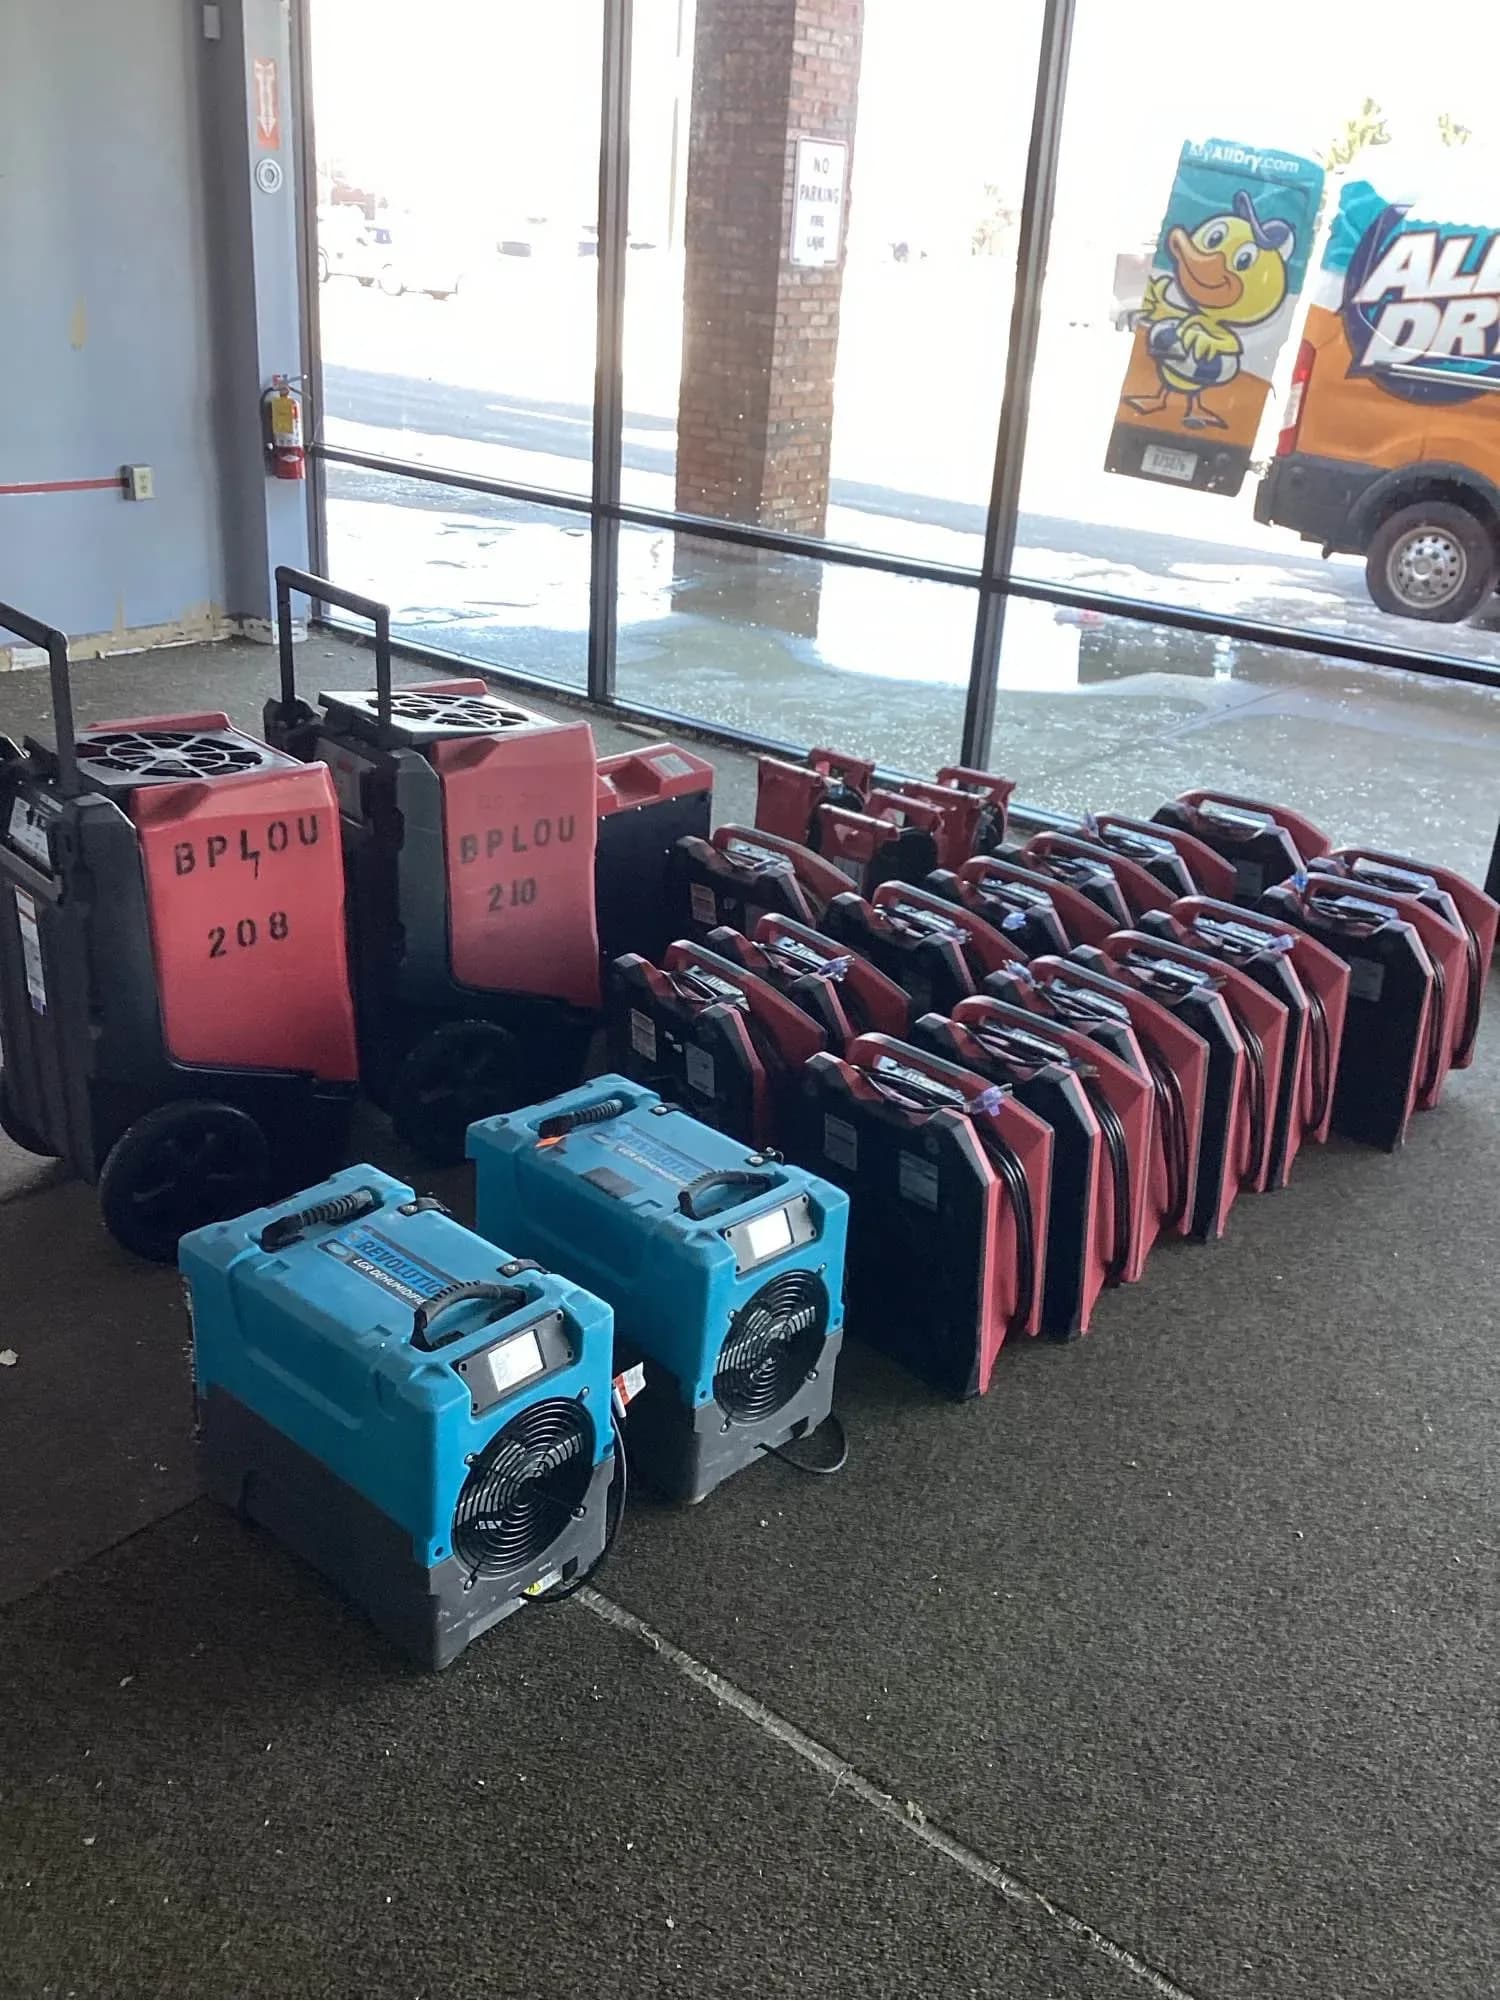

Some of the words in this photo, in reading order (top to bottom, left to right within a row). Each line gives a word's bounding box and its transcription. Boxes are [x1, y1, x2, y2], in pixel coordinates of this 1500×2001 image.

[813, 156, 830, 174] NO
[799, 183, 840, 205] PARKING
[1359, 297, 1500, 367] DR
[174, 814, 319, 877] BPLOU
[459, 815, 576, 865] BPLOU
[487, 877, 537, 912] 210
[207, 911, 289, 959] 208
[352, 1258, 374, 1273] LGR
[371, 1267, 427, 1305] DEHUMIDIFIE
[356, 1239, 445, 1295] REVOLUTIO
